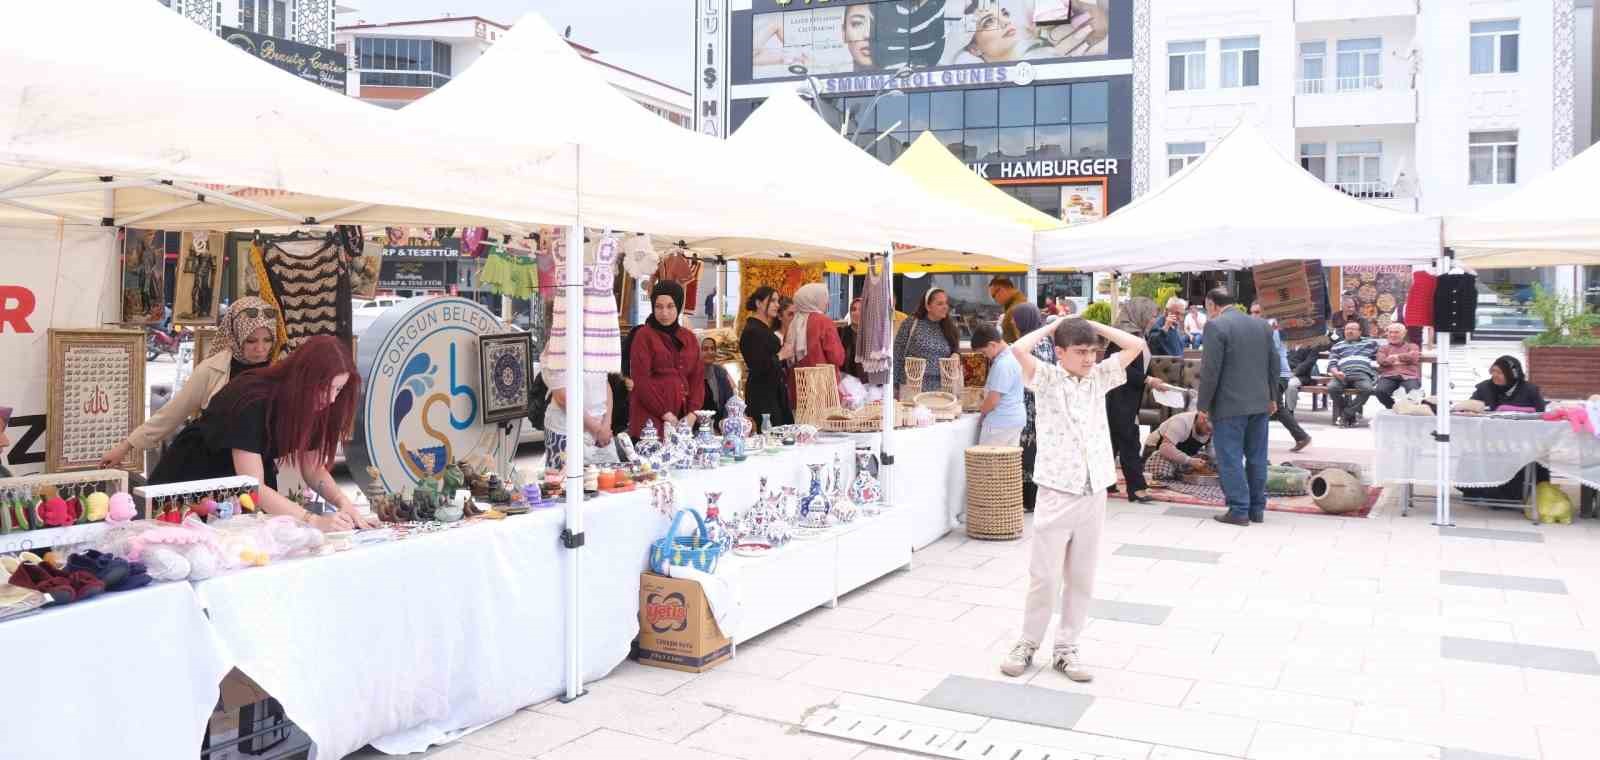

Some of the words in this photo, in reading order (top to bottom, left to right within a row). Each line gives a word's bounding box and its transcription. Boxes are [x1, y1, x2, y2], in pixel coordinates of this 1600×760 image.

[1000, 158, 1118, 178] HAMBURGER
[408, 247, 459, 257] TESETTÜR
[383, 311, 438, 378] SORGUN
